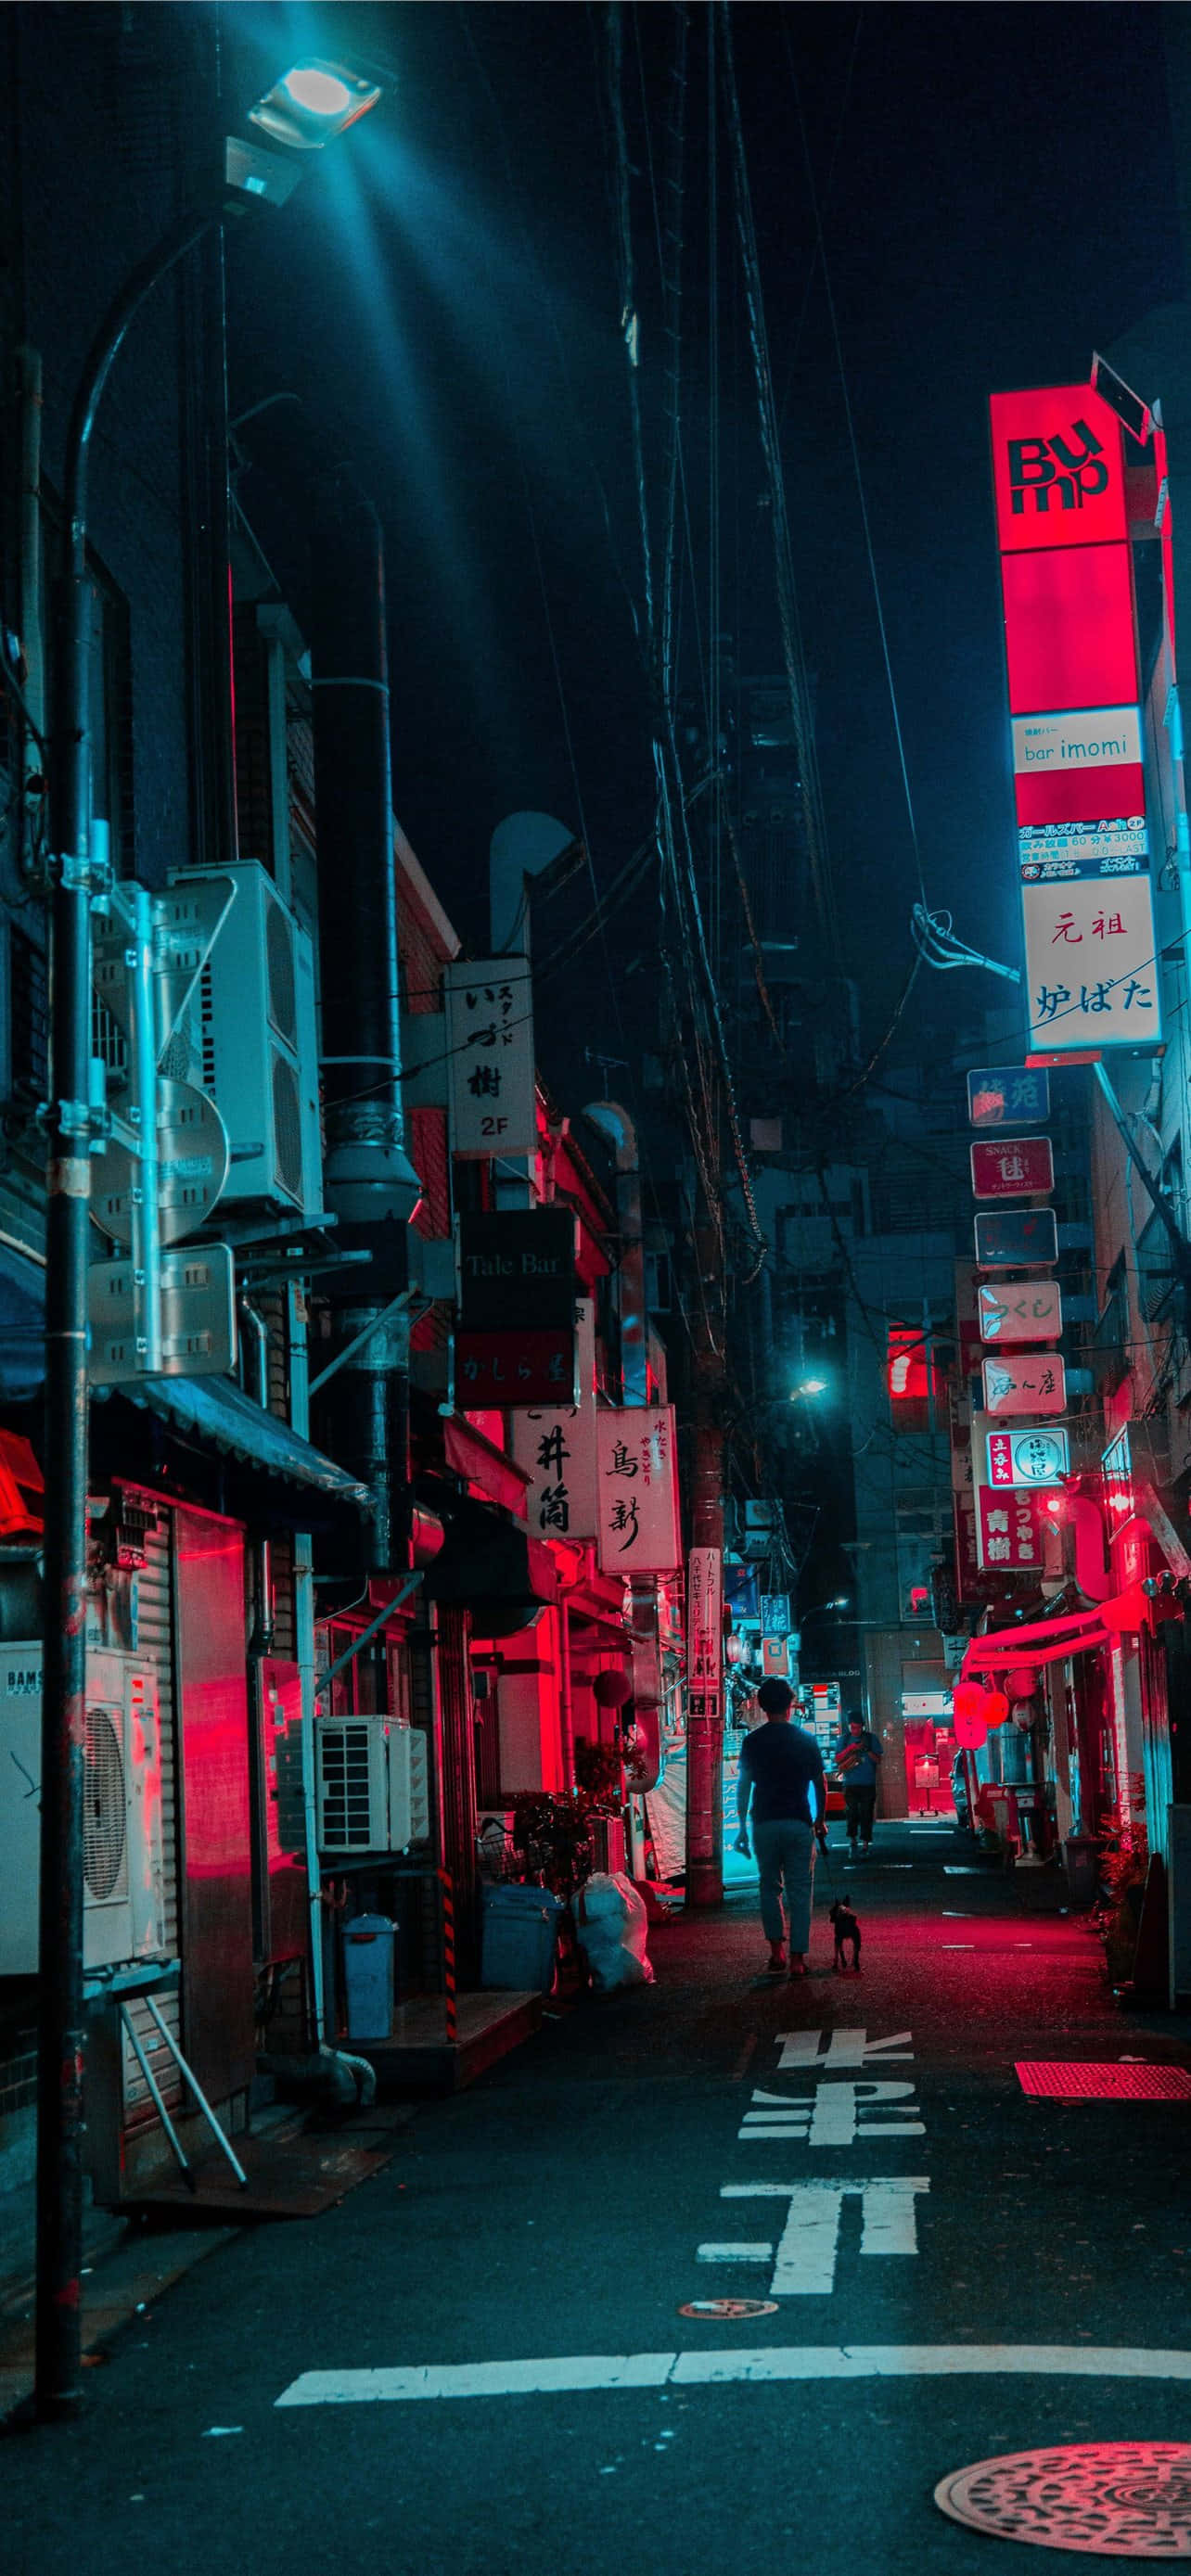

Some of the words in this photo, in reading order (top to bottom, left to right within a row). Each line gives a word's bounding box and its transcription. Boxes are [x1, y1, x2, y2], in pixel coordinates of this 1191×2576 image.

[1025, 746, 1055, 761] bar
[1060, 734, 1126, 759] imomi
[1051, 911, 1128, 944] 元祖
[1035, 978, 1153, 1018] 炉ばた
[481, 1116, 509, 1136] 2F
[986, 1145, 1021, 1156] SNACK
[520, 1253, 561, 1276] Bar
[535, 1424, 571, 1534] 井筒
[986, 1509, 1011, 1562] 青樹
